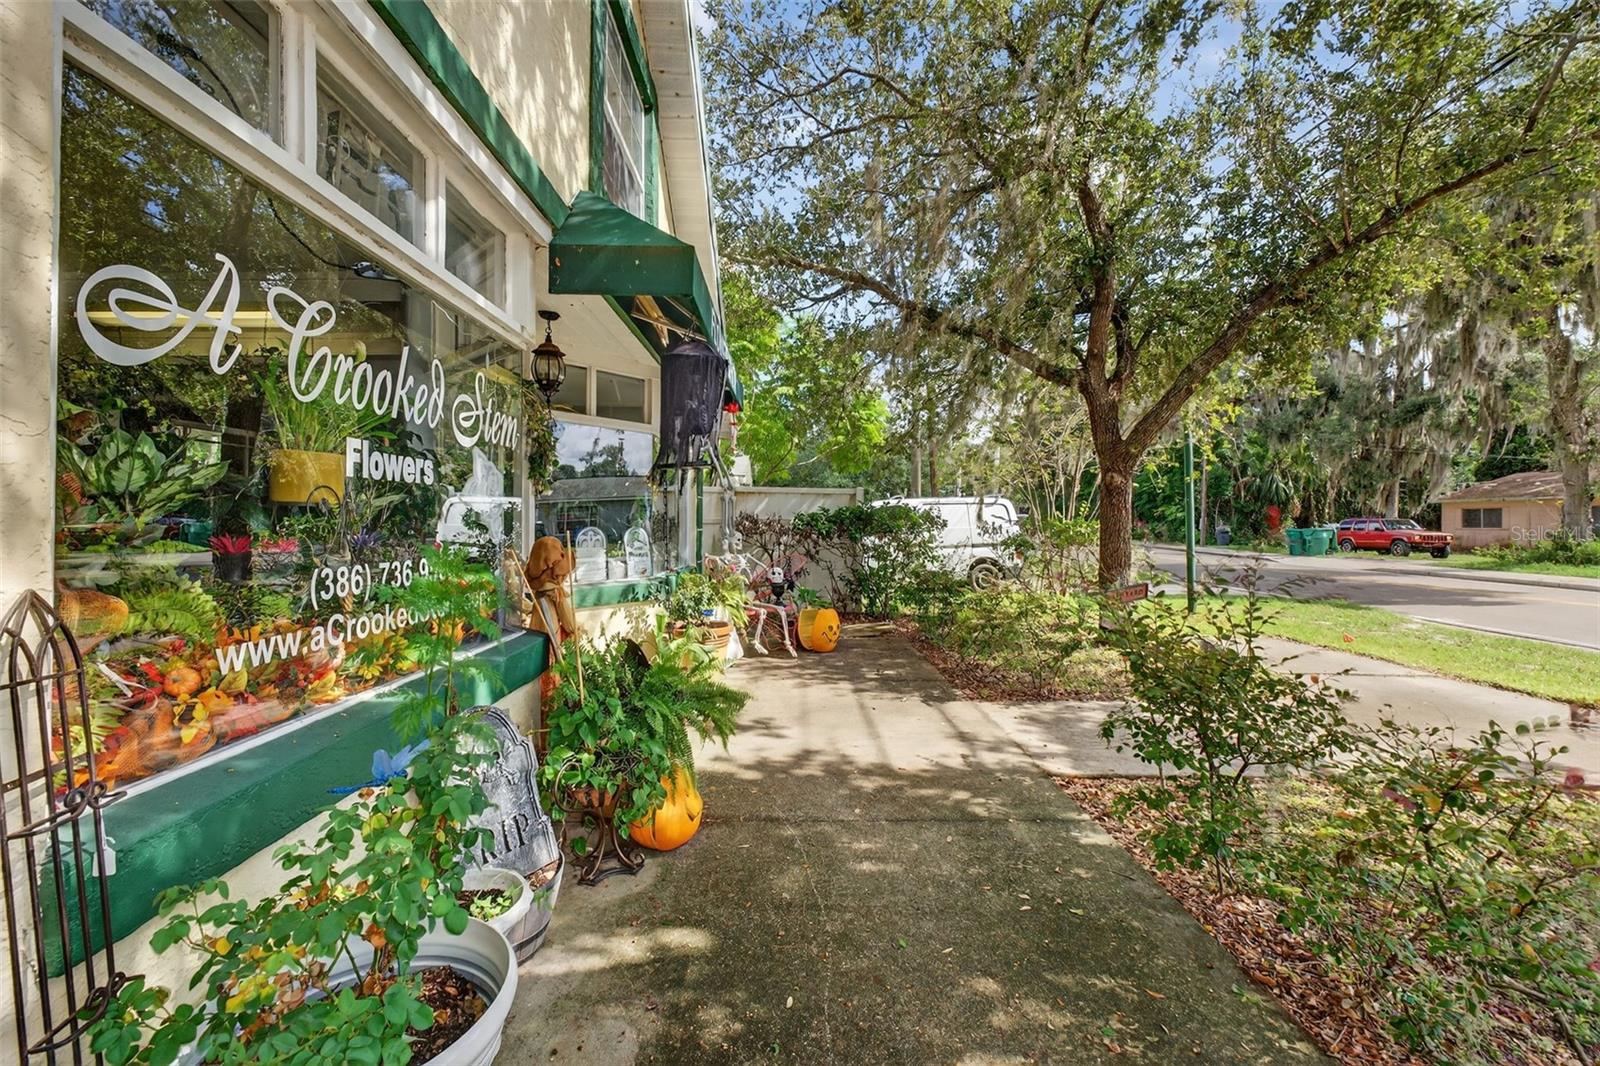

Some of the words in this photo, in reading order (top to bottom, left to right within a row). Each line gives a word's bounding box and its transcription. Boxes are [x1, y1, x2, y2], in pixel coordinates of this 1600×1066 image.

[76, 253, 242, 375] A
[268, 287, 444, 430] Crooked
[346, 437, 434, 486] Flowers
[310, 564, 371, 610] (386)
[378, 560, 413, 588] 736
